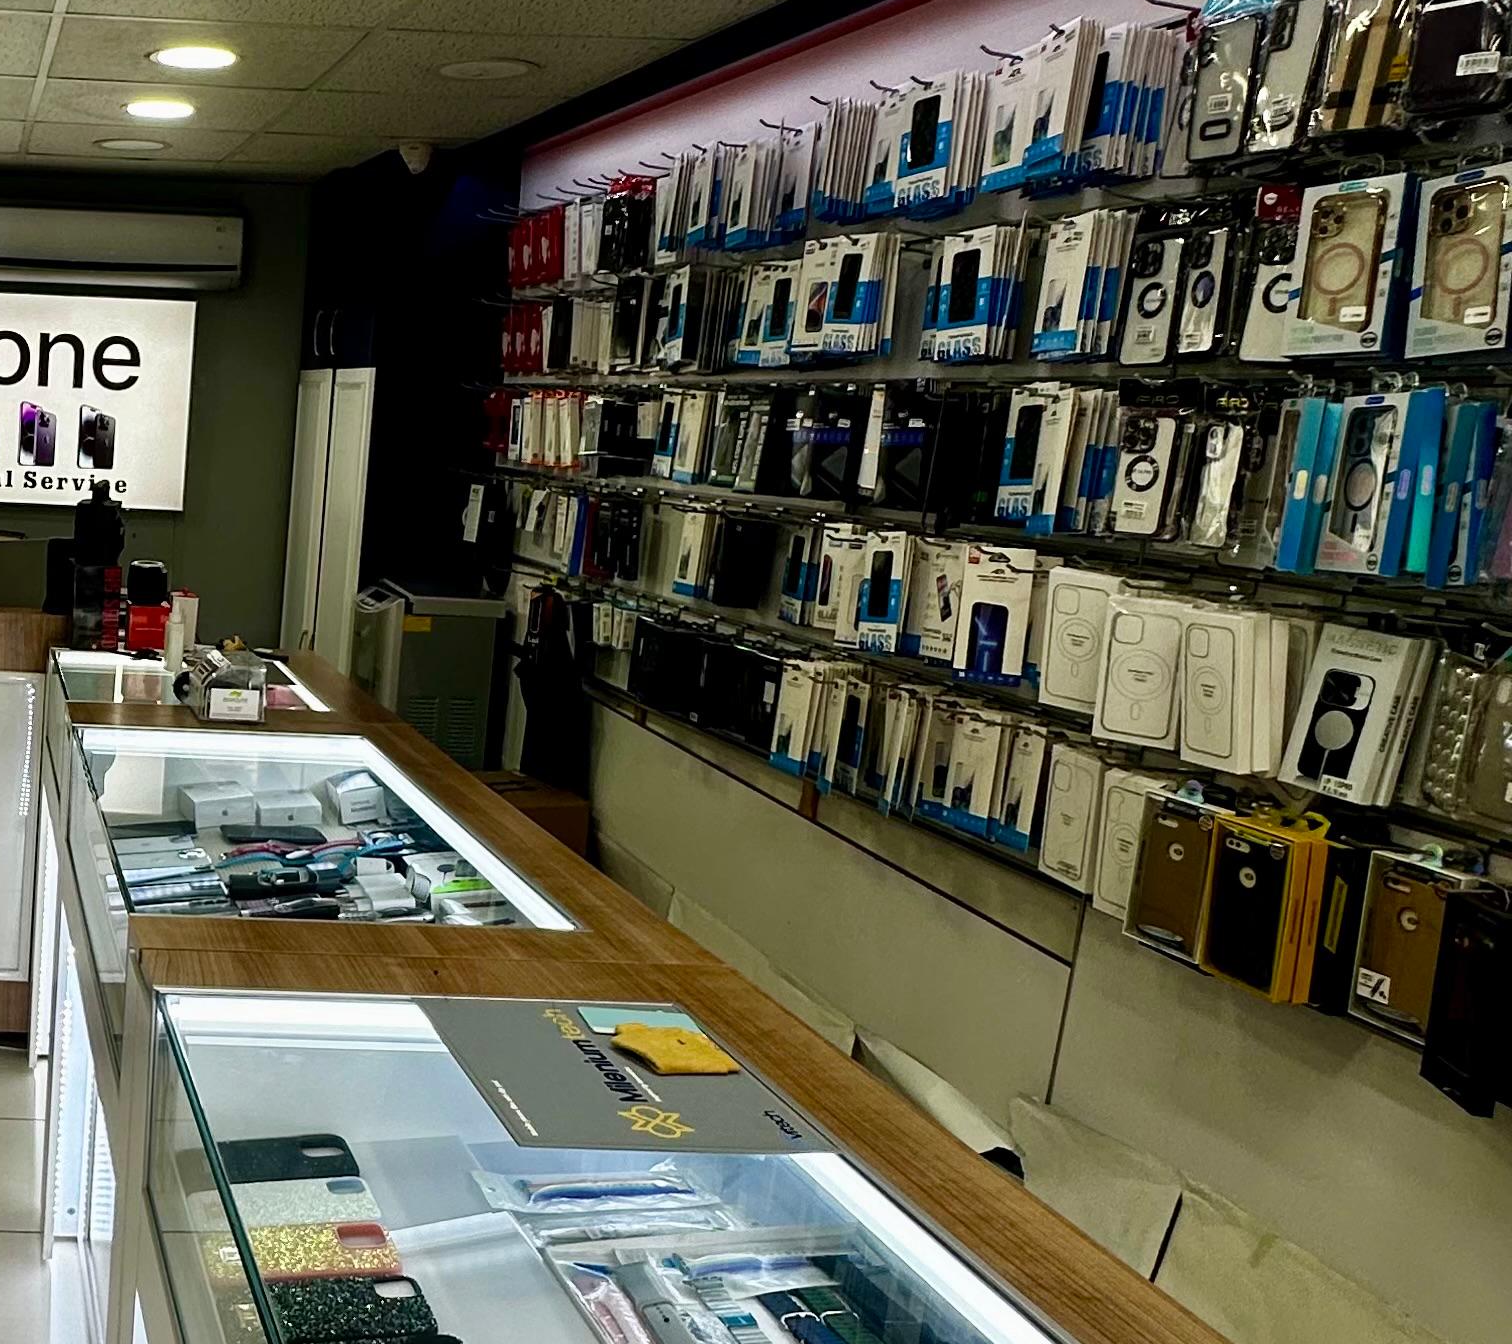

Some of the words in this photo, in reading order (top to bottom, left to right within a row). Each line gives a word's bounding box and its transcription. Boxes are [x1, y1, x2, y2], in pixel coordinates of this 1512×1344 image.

[936, 337, 982, 360] GLASS
[23, 470, 128, 494] Servie
[998, 496, 1029, 518] GLAS
[859, 632, 892, 651] GLASS
